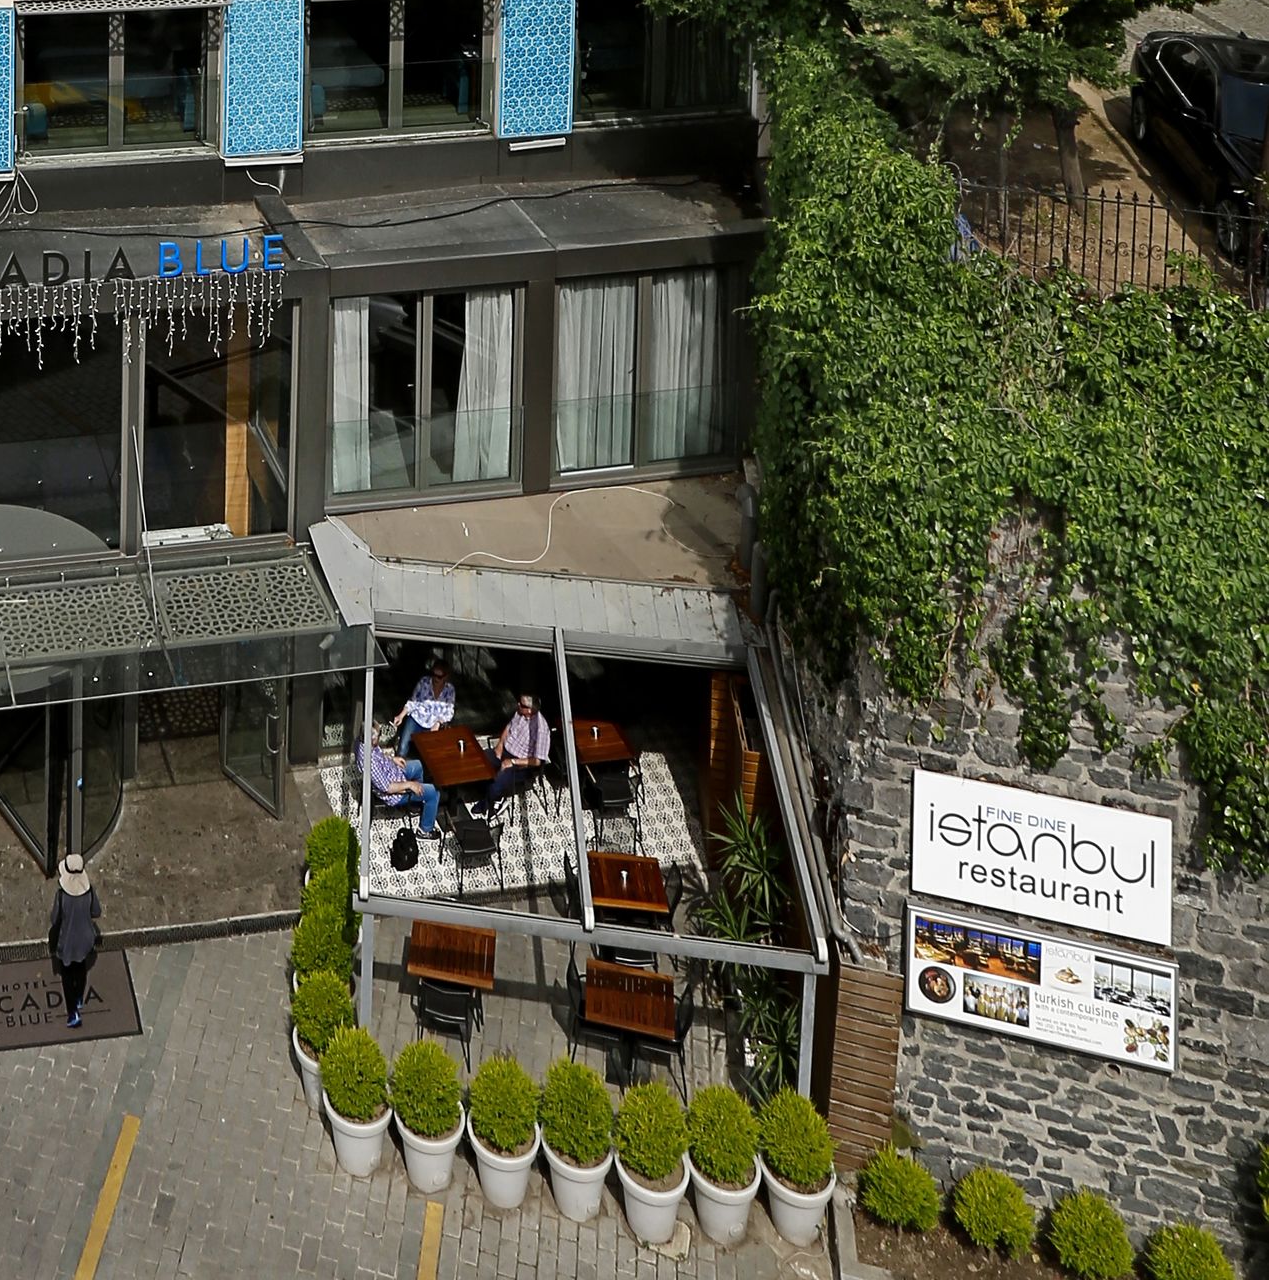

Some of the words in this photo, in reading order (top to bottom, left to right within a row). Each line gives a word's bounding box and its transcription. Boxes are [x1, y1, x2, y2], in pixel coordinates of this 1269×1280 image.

[158, 233, 284, 279] BLUE
[985, 806, 1022, 824] FINE
[1027, 814, 1067, 833] DINE
[929, 802, 1155, 888] istanbul
[958, 860, 1124, 914] restaurant
[1, 980, 48, 992] HOTEL
[6, 1011, 53, 1028] BLUE
[1034, 991, 1074, 1010] turkish
[1077, 1002, 1119, 1021] cuisine
